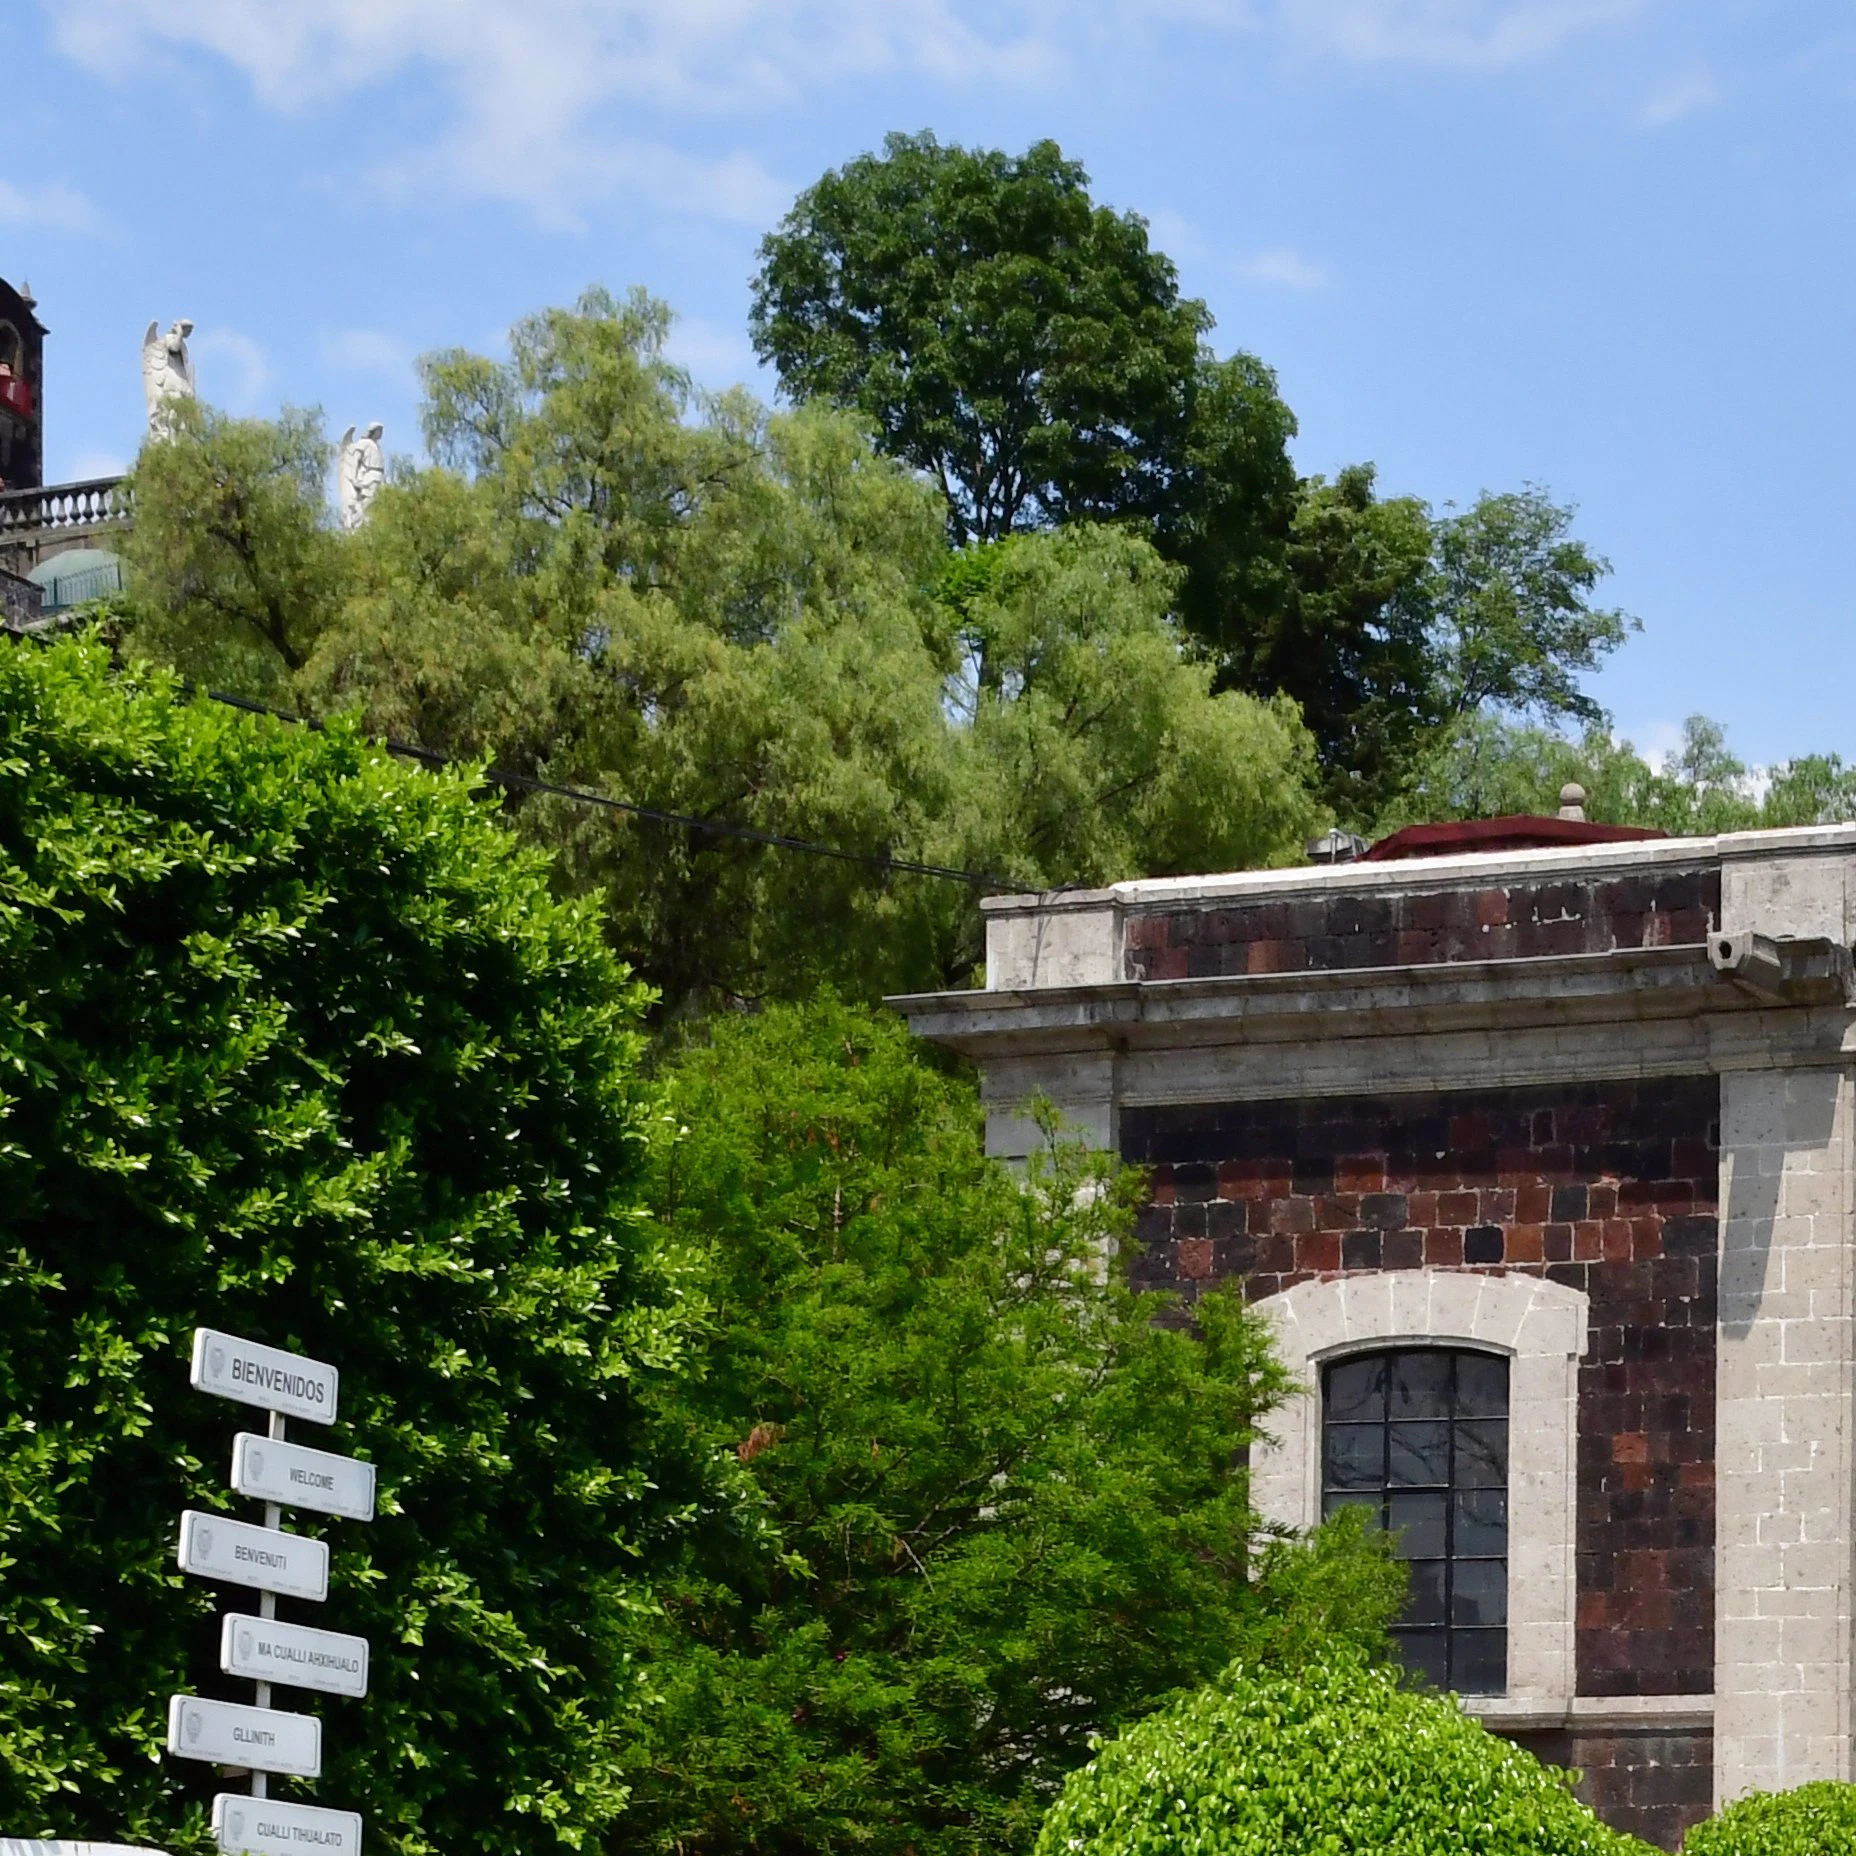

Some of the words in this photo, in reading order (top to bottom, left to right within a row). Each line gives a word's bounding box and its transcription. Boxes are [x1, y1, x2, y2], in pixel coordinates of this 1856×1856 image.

[232, 1358, 324, 1404] BIENVENIDOS
[289, 1467, 334, 1491] WELCOME
[234, 1545, 287, 1570] BENVENUTI
[258, 1641, 271, 1657] MA
[273, 1645, 306, 1664] CUALLI
[257, 1822, 291, 1840] CUALLI
